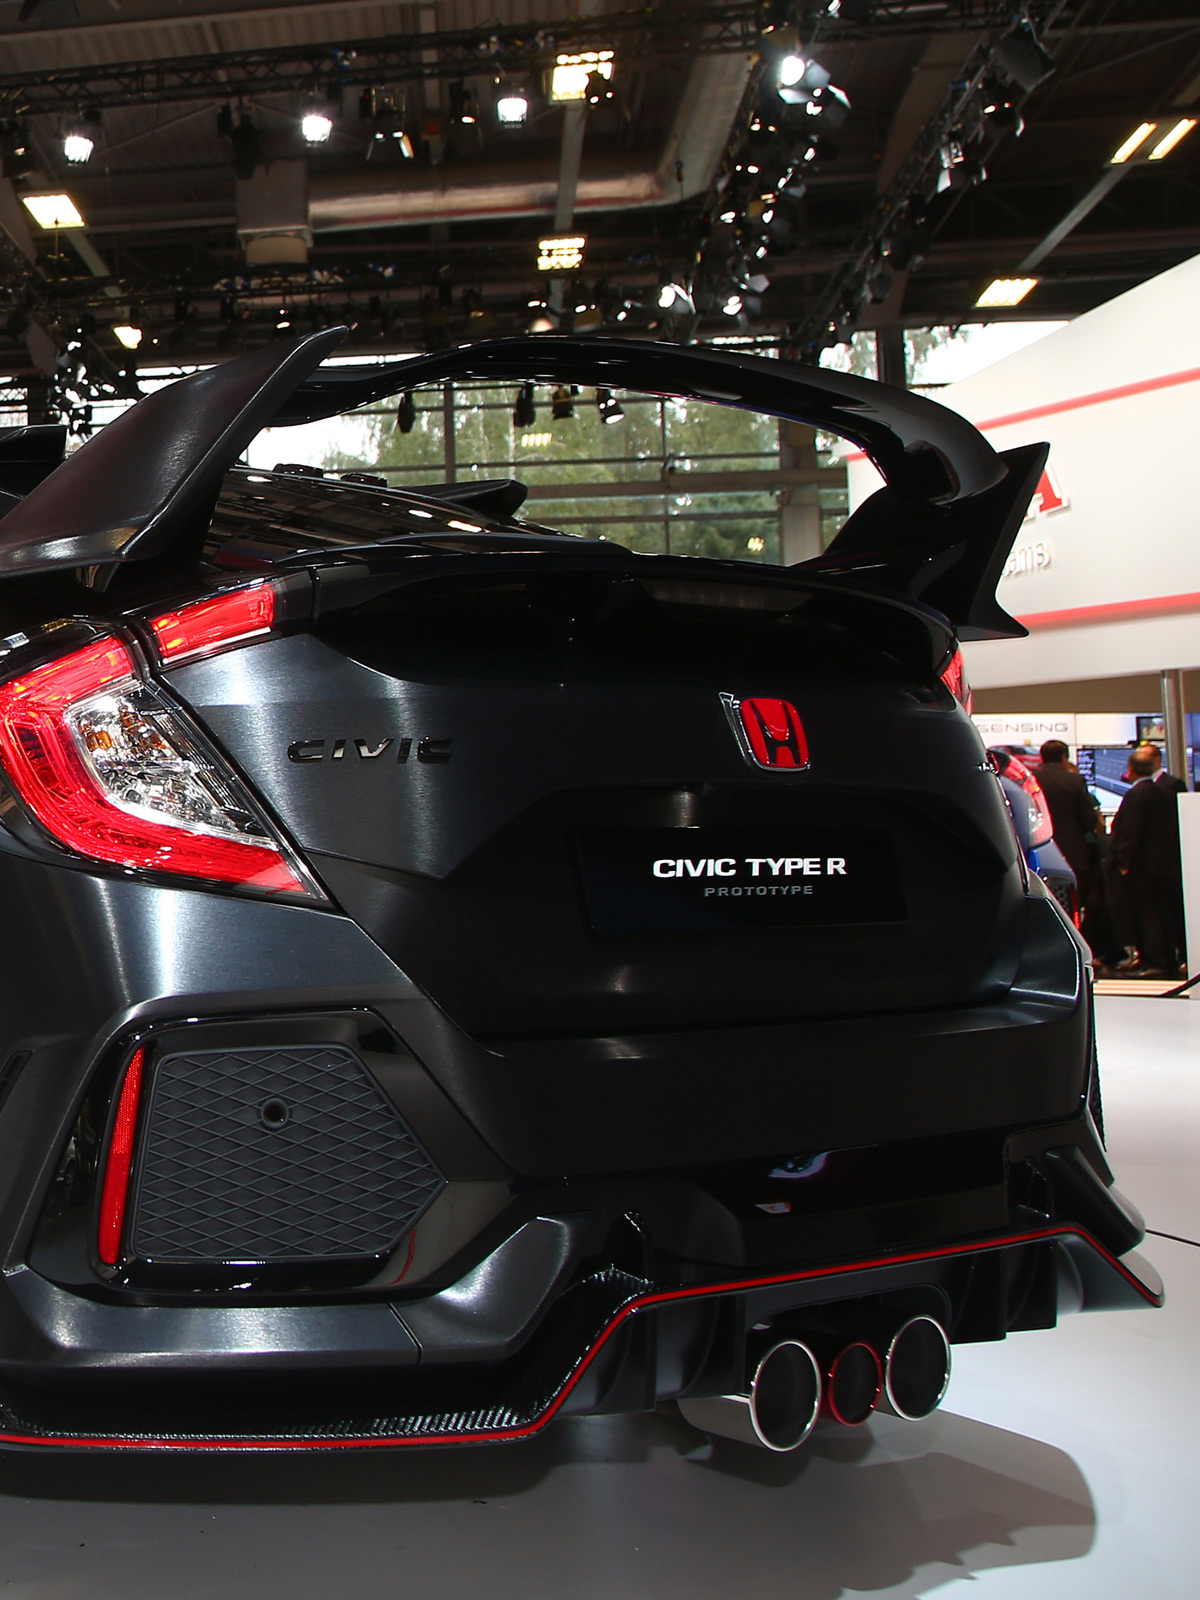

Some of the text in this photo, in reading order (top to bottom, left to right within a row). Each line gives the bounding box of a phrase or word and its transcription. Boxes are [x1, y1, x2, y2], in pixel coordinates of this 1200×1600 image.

[287, 734, 454, 764] CIVIC
[652, 857, 847, 879] CIVIC TYPE R
[703, 885, 814, 897] PROTOTYPE
